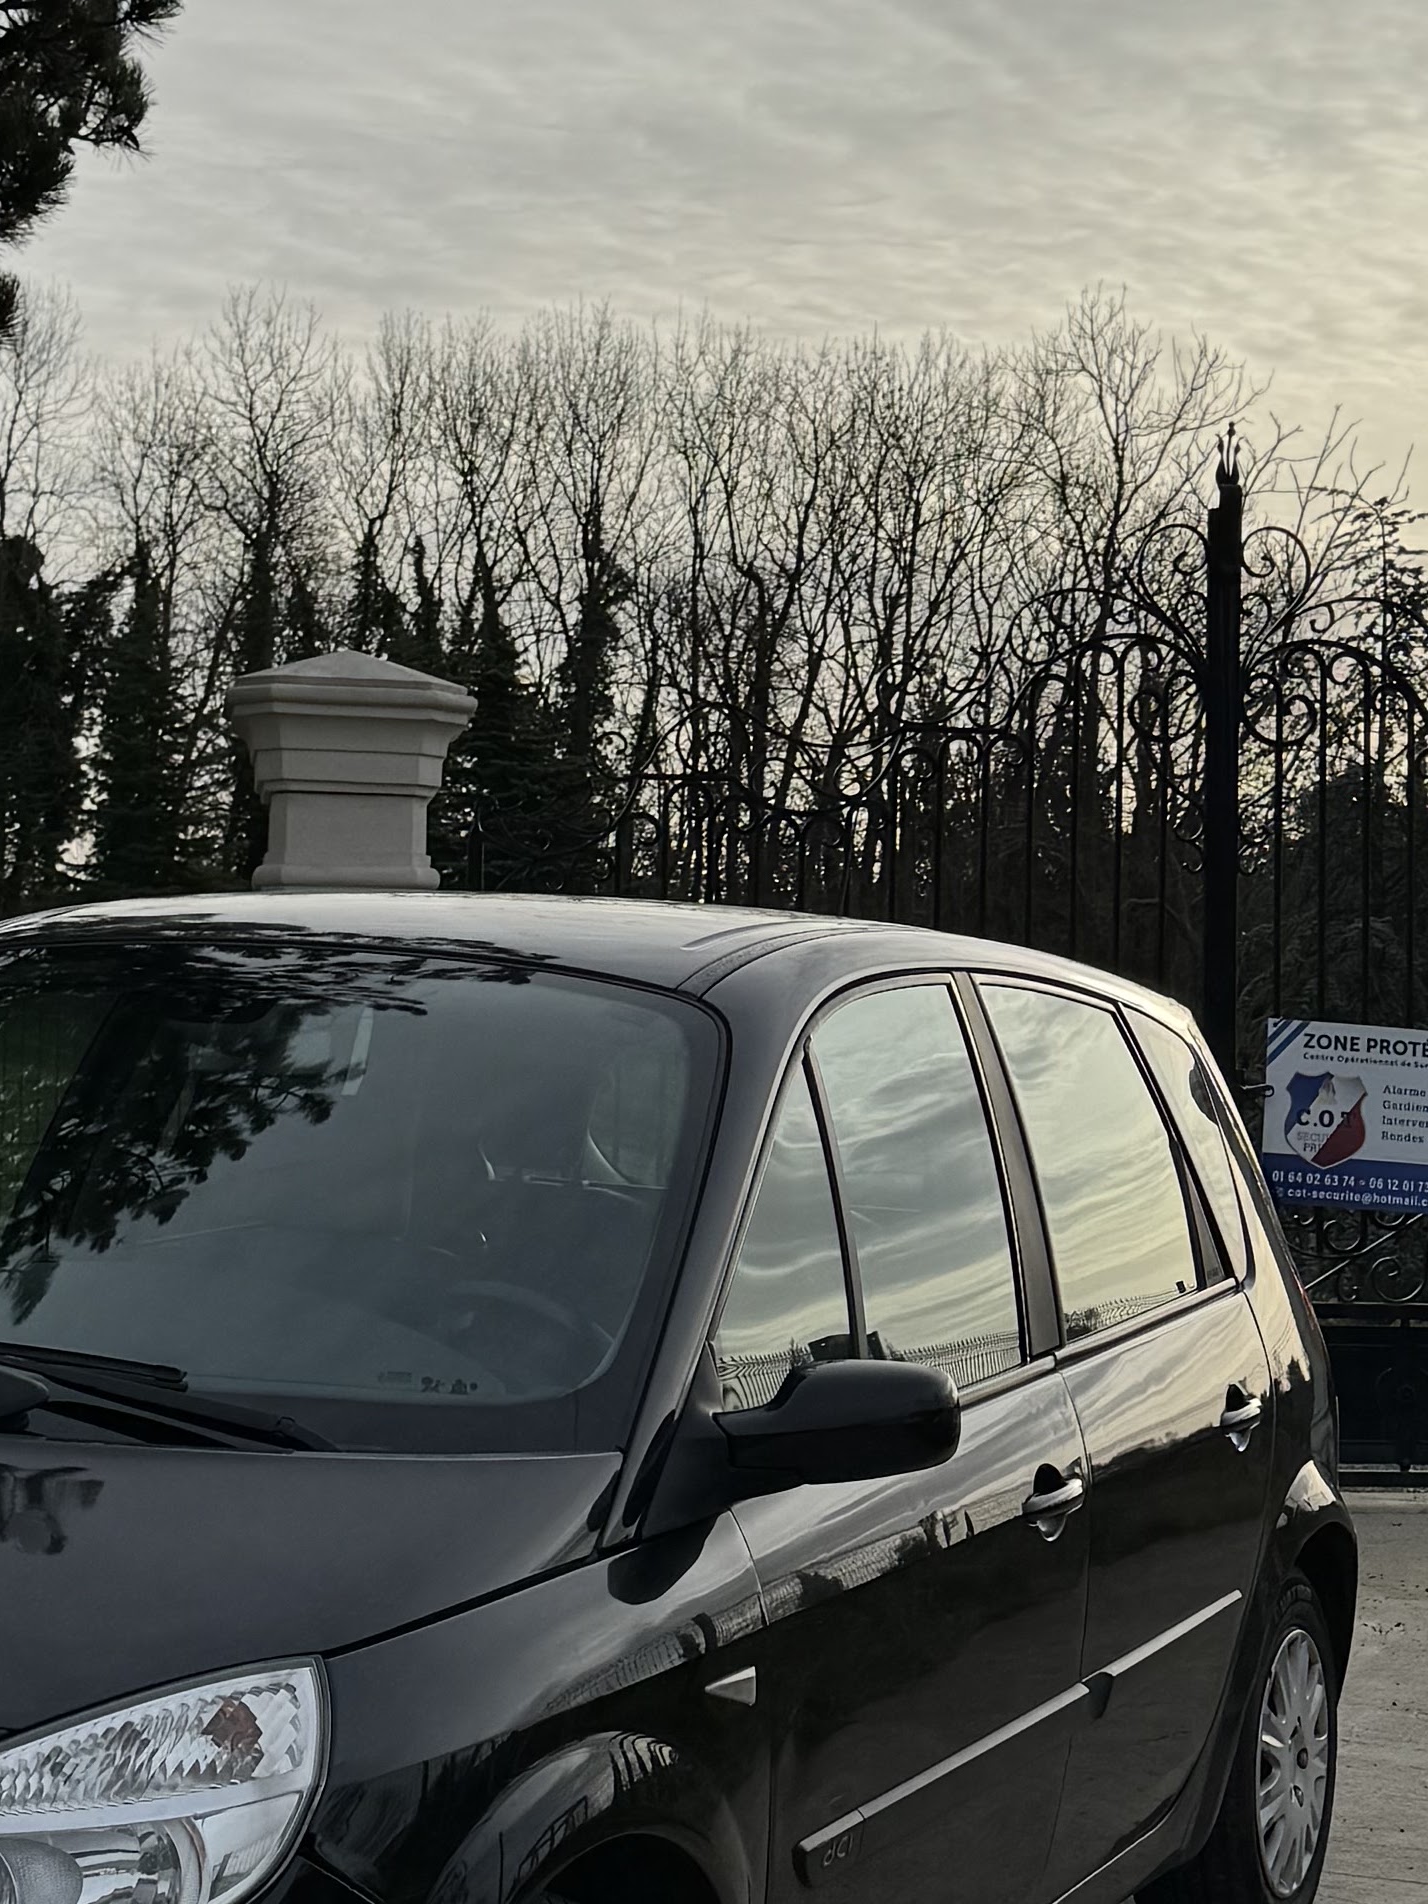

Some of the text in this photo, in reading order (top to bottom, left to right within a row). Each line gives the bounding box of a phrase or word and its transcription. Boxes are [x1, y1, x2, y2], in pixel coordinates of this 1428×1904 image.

[1302, 1032, 1361, 1053] ZONE
[1382, 1084, 1427, 1097] Alarme
[1381, 1130, 1424, 1143] Rondes
[1272, 1170, 1284, 1182] 01
[1288, 1172, 1303, 1183] 64
[1306, 1173, 1321, 1185] 02
[1324, 1174, 1339, 1186] 63
[1342, 1175, 1355, 1188] 74
[1369, 1177, 1384, 1190] 06
[1387, 1179, 1399, 1191] 12
[1402, 1180, 1414, 1193] 01
